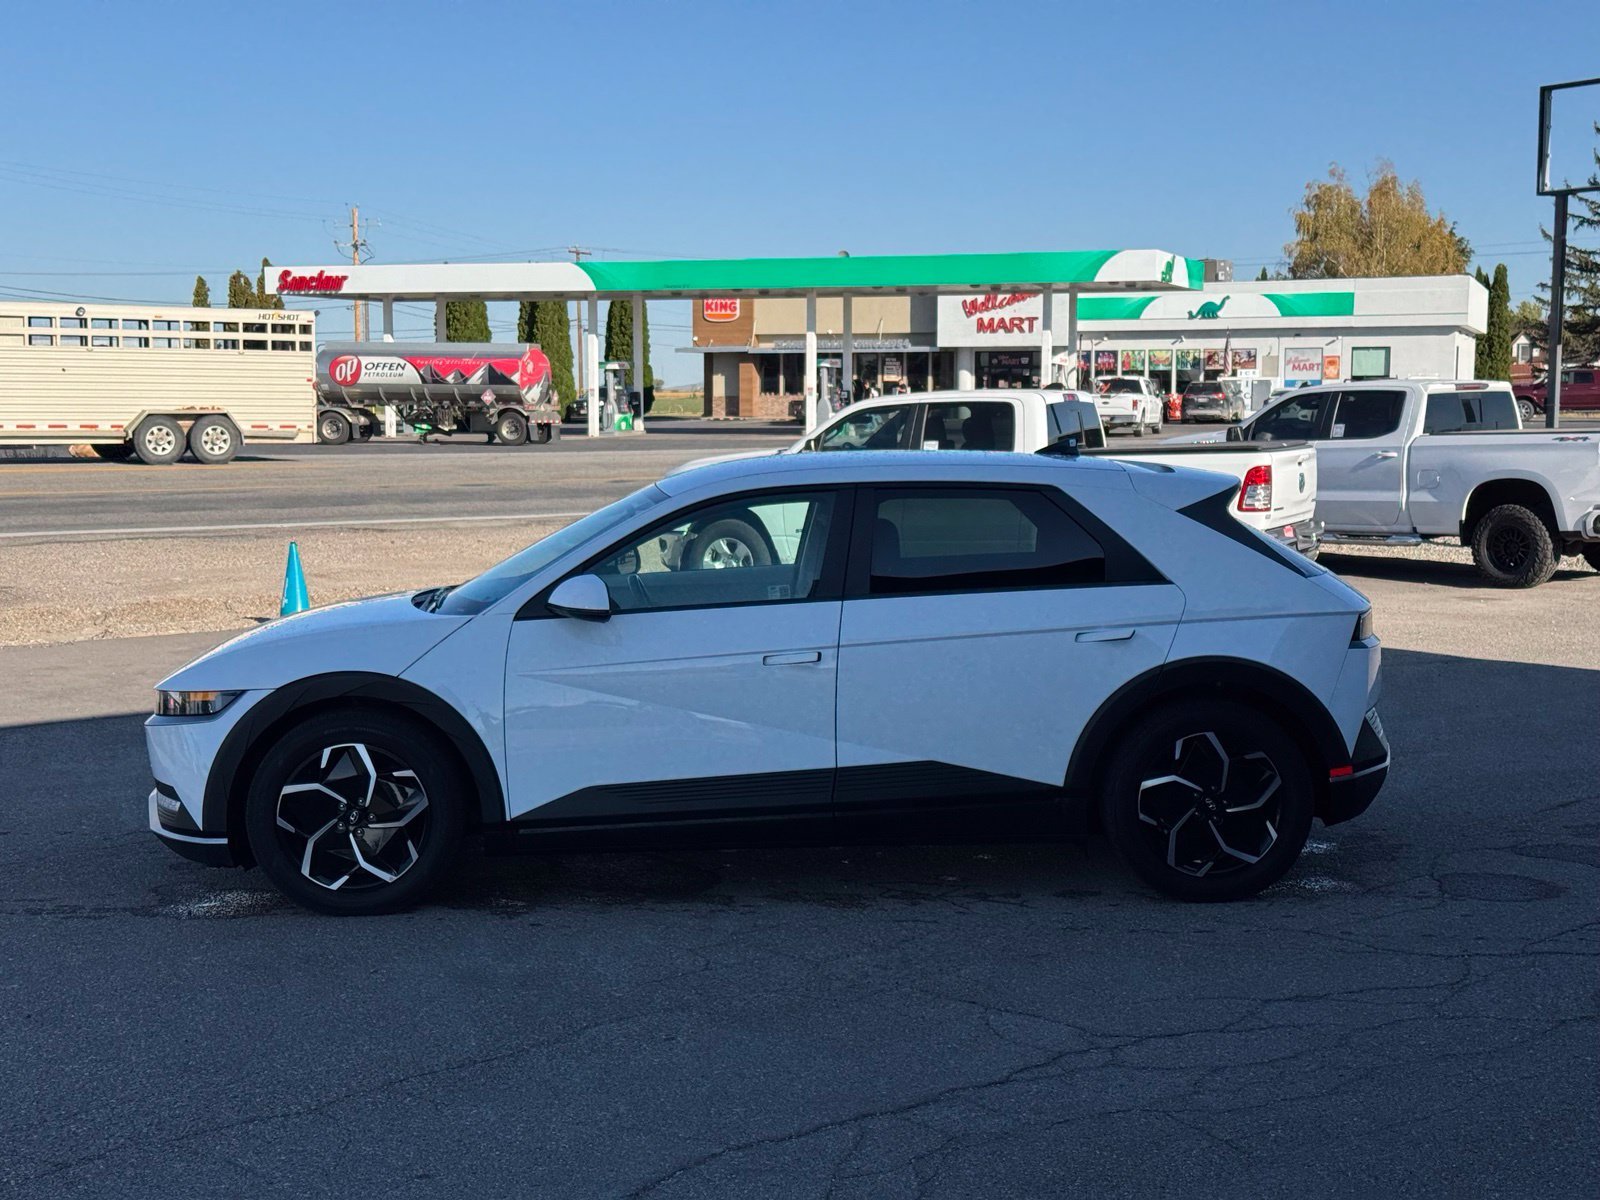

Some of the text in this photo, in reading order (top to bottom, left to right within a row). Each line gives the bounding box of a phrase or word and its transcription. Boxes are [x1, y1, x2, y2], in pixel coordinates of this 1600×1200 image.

[276, 269, 349, 293] Sinclair
[705, 301, 737, 312] KING
[976, 317, 1039, 334] MART
[364, 362, 407, 371] OFFEN
[1291, 363, 1321, 372] MART
